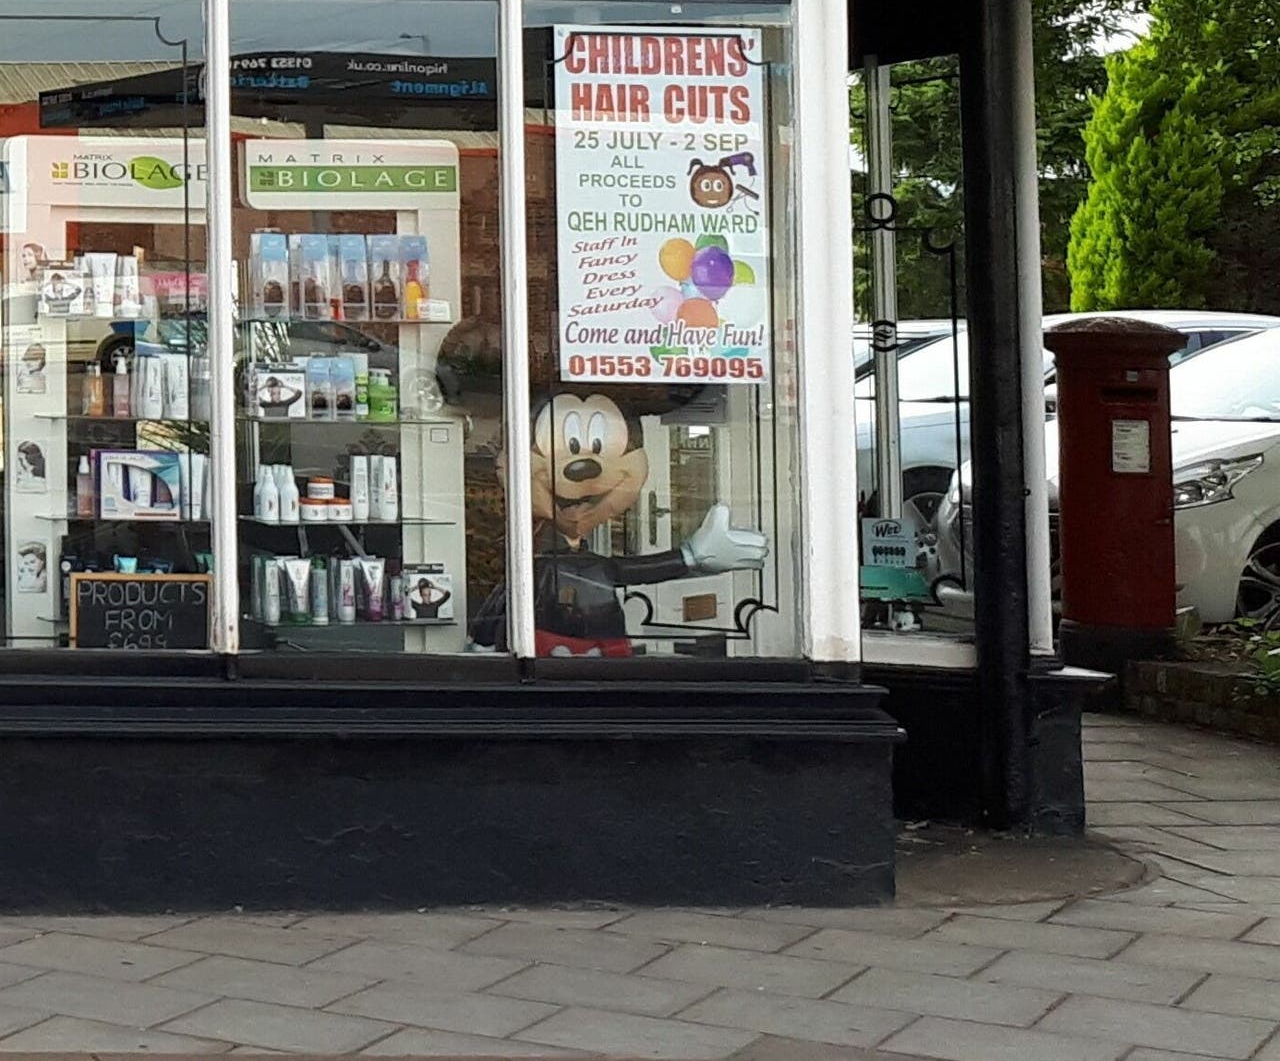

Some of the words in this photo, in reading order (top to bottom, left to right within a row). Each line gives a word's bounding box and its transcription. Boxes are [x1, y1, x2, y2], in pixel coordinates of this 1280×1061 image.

[564, 33, 755, 78] CHILDRENS'
[570, 82, 651, 123] HAIR
[663, 84, 751, 125] CUTS
[573, 131, 599, 149] 25
[606, 132, 663, 150] JULY
[683, 133, 696, 151] 2
[703, 133, 748, 152] SEP
[258, 154, 385, 164] MATRIX
[610, 155, 645, 169] ALL
[73, 161, 208, 181] BIOLAGE
[278, 170, 449, 187] BIOLAGE
[578, 173, 677, 189] PROCEEDS
[618, 194, 643, 208] TO
[567, 211, 608, 232] QEH
[613, 212, 696, 233] RUDHAM
[701, 213, 758, 234] WARD
[571, 236, 618, 254] Staff
[619, 235, 638, 248] In
[578, 252, 639, 269] Fancy
[582, 269, 637, 285] Dress
[585, 284, 644, 300] Every
[567, 296, 665, 318] Saturday
[565, 320, 620, 344] Come
[624, 324, 662, 345] and
[666, 322, 717, 347] Have
[722, 323, 765, 347] Fun!
[568, 354, 652, 377] 01553
[661, 356, 764, 379] 769095
[77, 580, 207, 607] PRODUCTS
[104, 608, 173, 631] FROM
